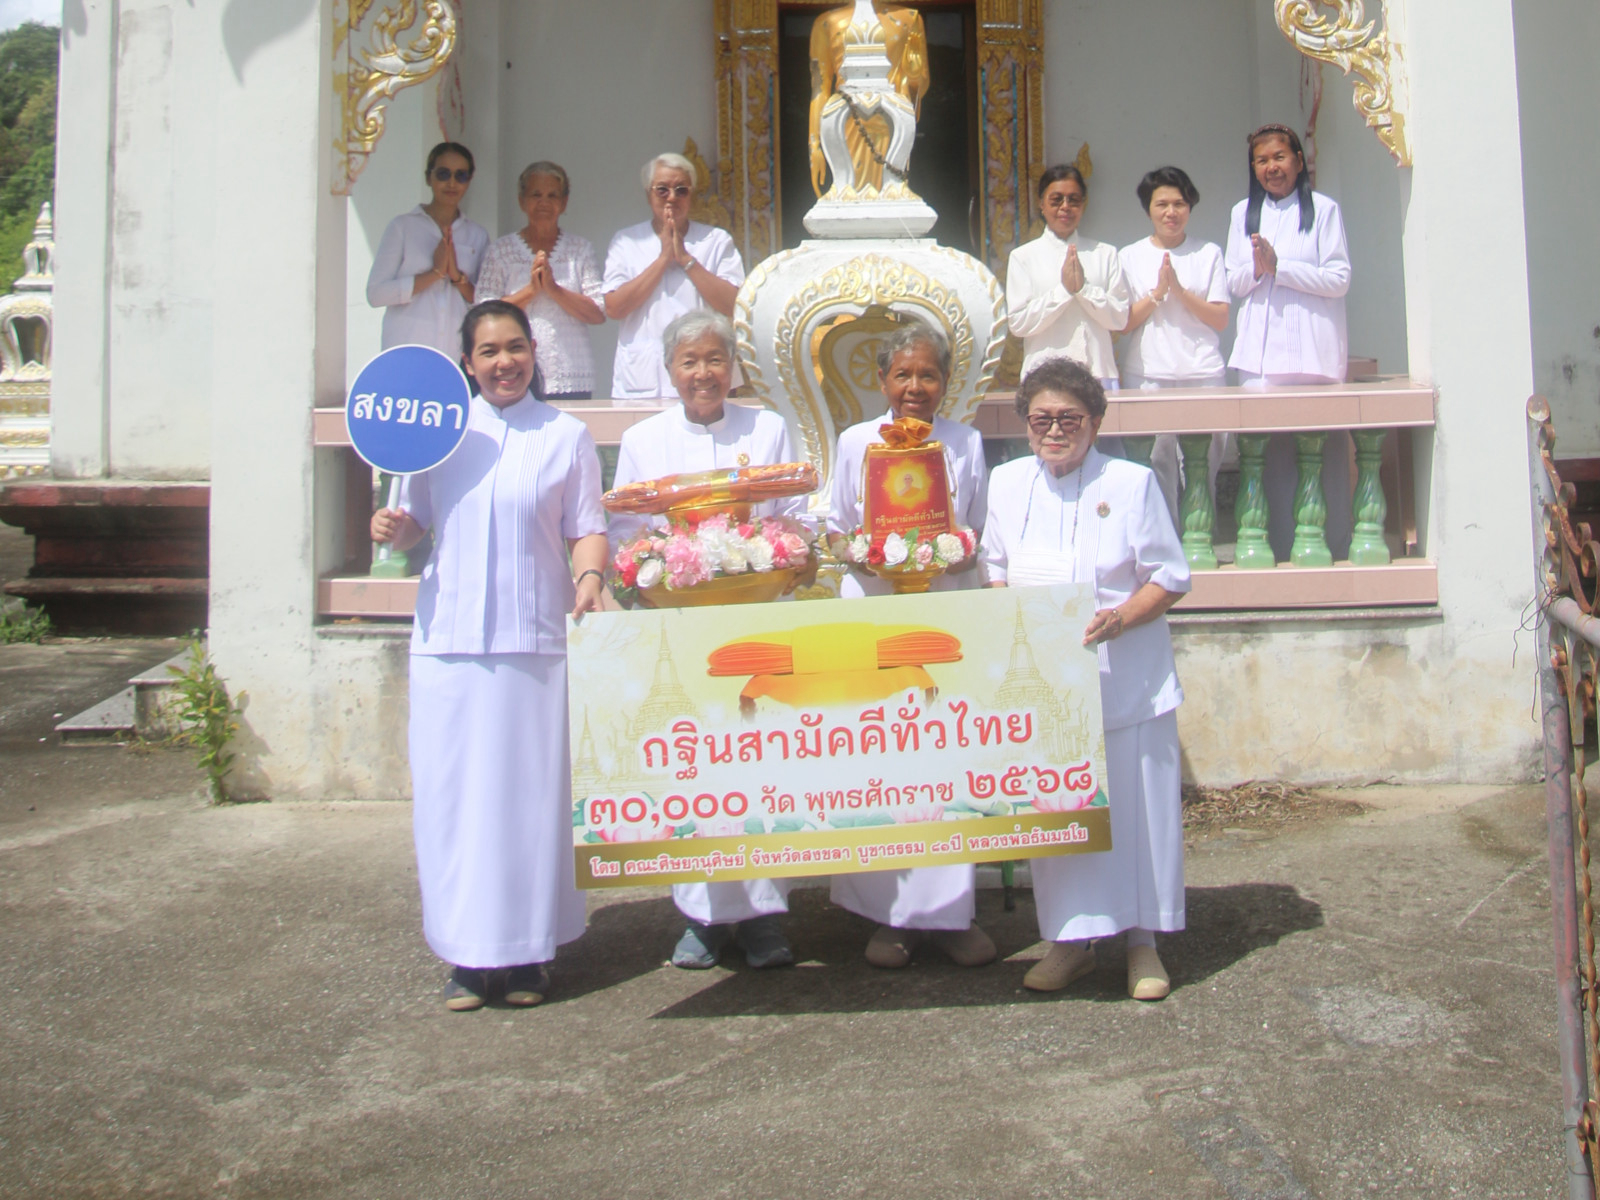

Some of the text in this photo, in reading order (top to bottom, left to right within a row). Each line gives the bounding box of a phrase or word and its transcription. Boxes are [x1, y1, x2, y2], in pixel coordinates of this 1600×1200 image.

[353, 392, 463, 430] สงขลา
[643, 694, 1032, 779] กฐินสามัคคีทั่วไทย
[589, 760, 1093, 829] ๓๐,๐๐๐ วัด พุทธศักราช ๒๕๖๘
[590, 857, 619, 877] โดย
[626, 846, 745, 875] คณะศิษยานุศิษย์
[751, 845, 850, 865] จังหวัดสงขลา
[858, 842, 925, 863] บูชาธรรม
